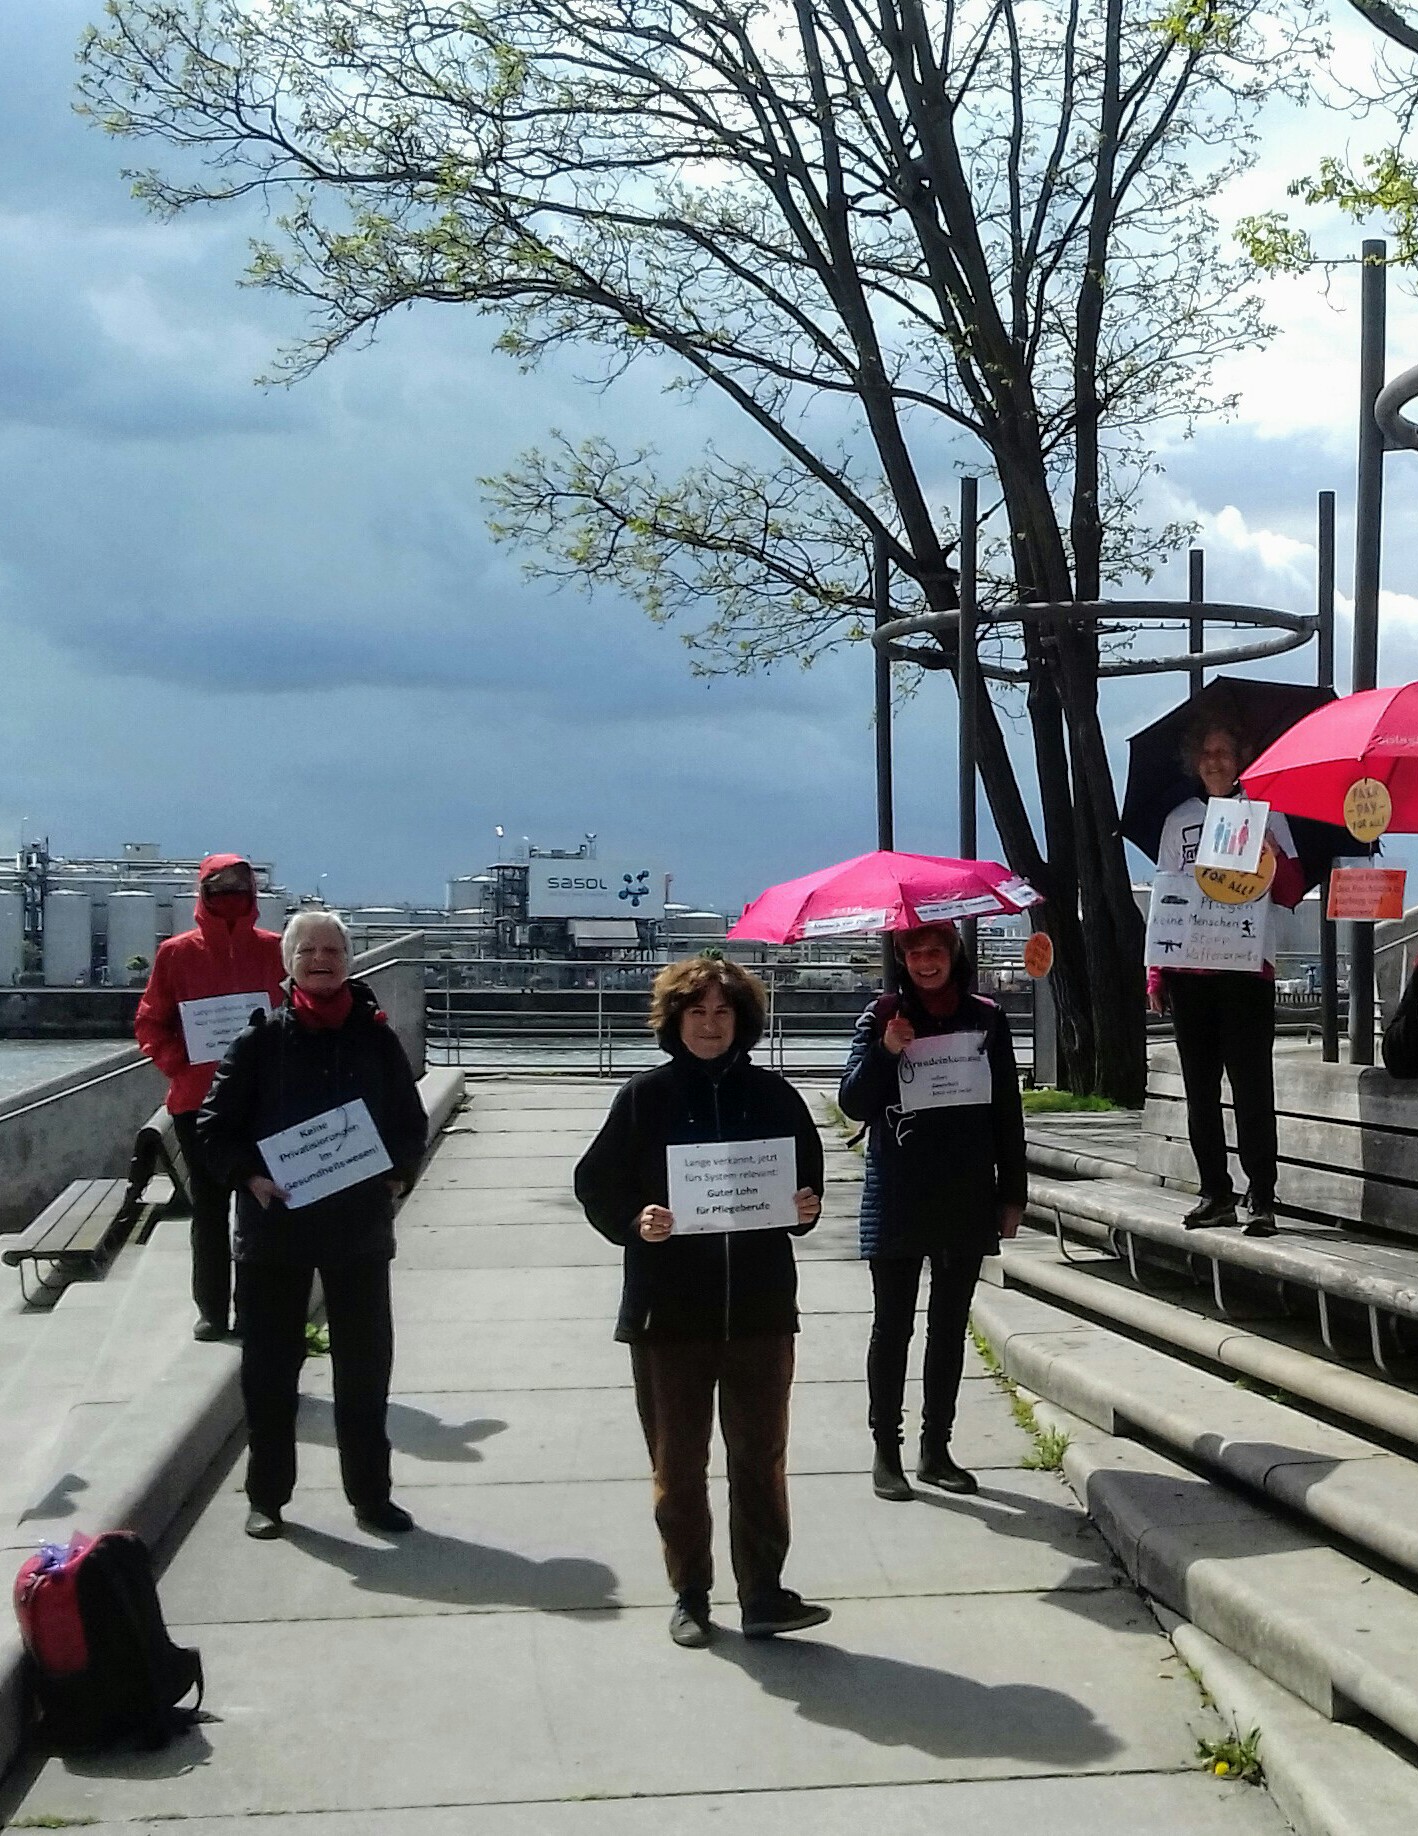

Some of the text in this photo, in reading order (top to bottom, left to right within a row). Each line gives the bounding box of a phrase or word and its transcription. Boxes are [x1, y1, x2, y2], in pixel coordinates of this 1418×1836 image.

[548, 877, 607, 890] sasol
[1202, 868, 1254, 895] FOR ALL!
[1189, 914, 1240, 927] Menschen
[300, 1122, 328, 1138] Keine
[685, 1153, 778, 1168] Lange verkannt, jetzt
[685, 1173, 702, 1182] fürs
[704, 1172, 738, 1182] System
[707, 1186, 758, 1198] Guter Lohn
[696, 1201, 770, 1215] für Pflegeberufe
